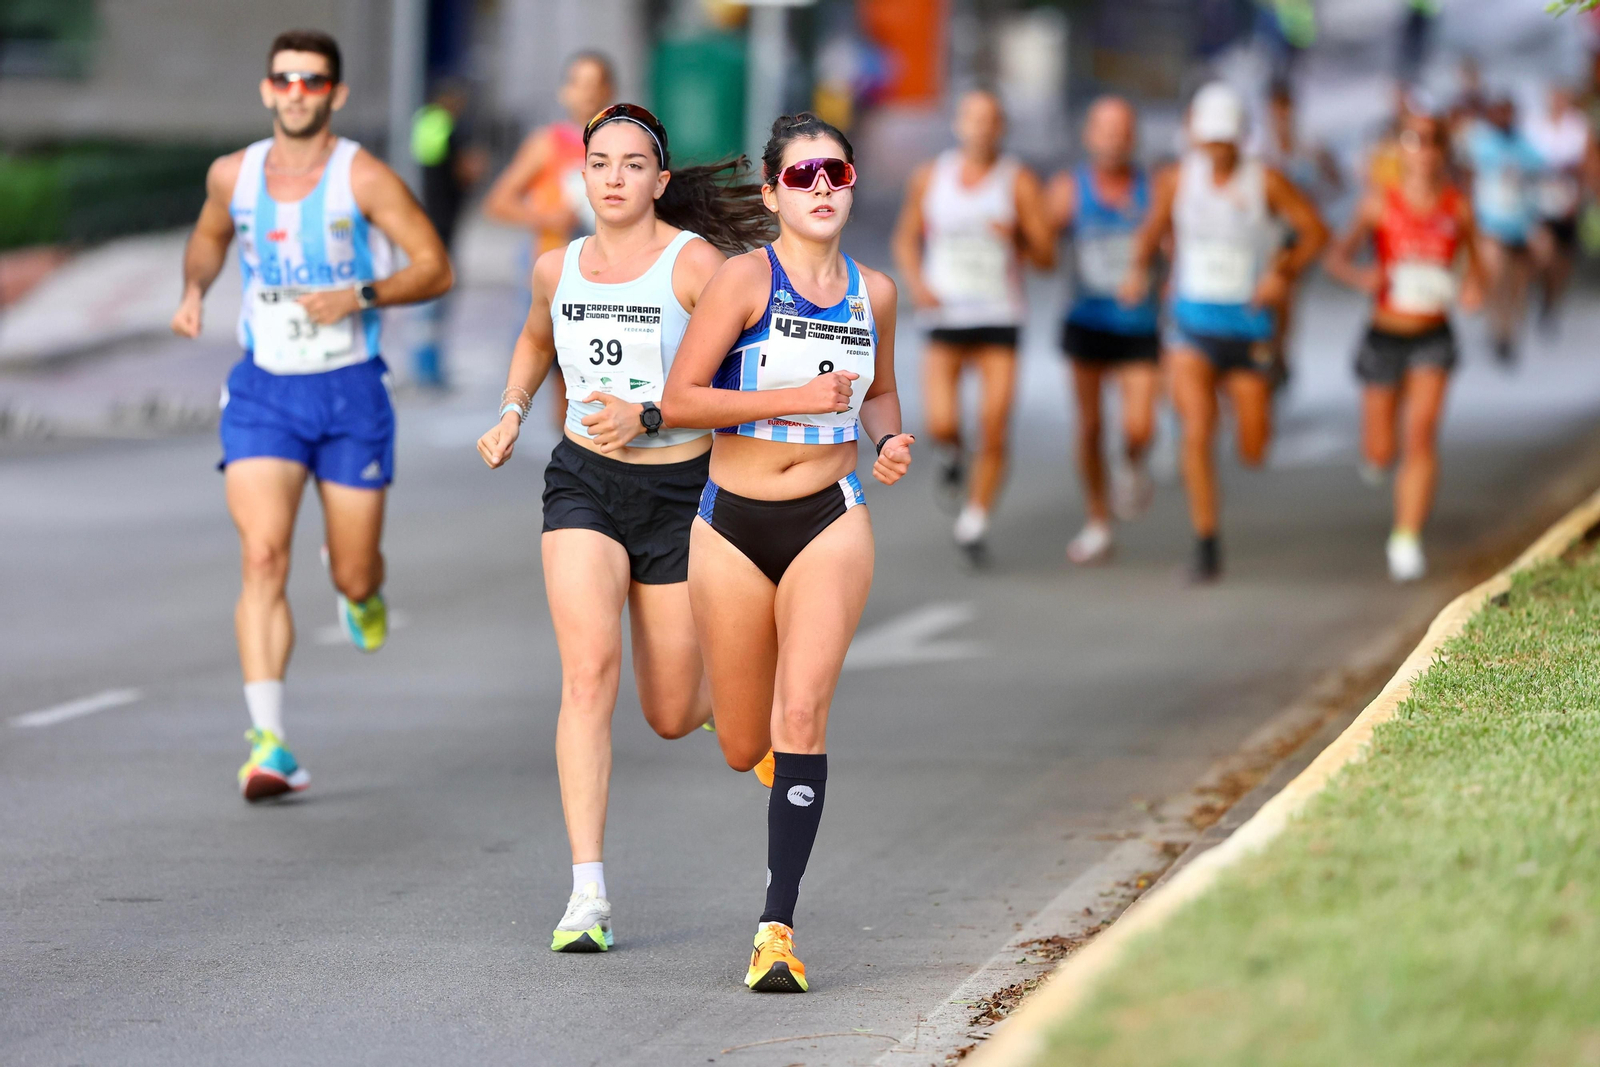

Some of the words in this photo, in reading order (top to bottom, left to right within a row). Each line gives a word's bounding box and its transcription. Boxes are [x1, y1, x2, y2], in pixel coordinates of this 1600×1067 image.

[562, 303, 586, 321] 43
[586, 304, 624, 312] CARRERA
[626, 306, 661, 314] URBANA
[775, 318, 808, 339] 43
[808, 322, 848, 334] CARRERA
[849, 327, 870, 336] URBANA
[808, 331, 834, 340] CIUDAD
[589, 338, 623, 366] 39
[767, 419, 802, 427] EUROPEAN
